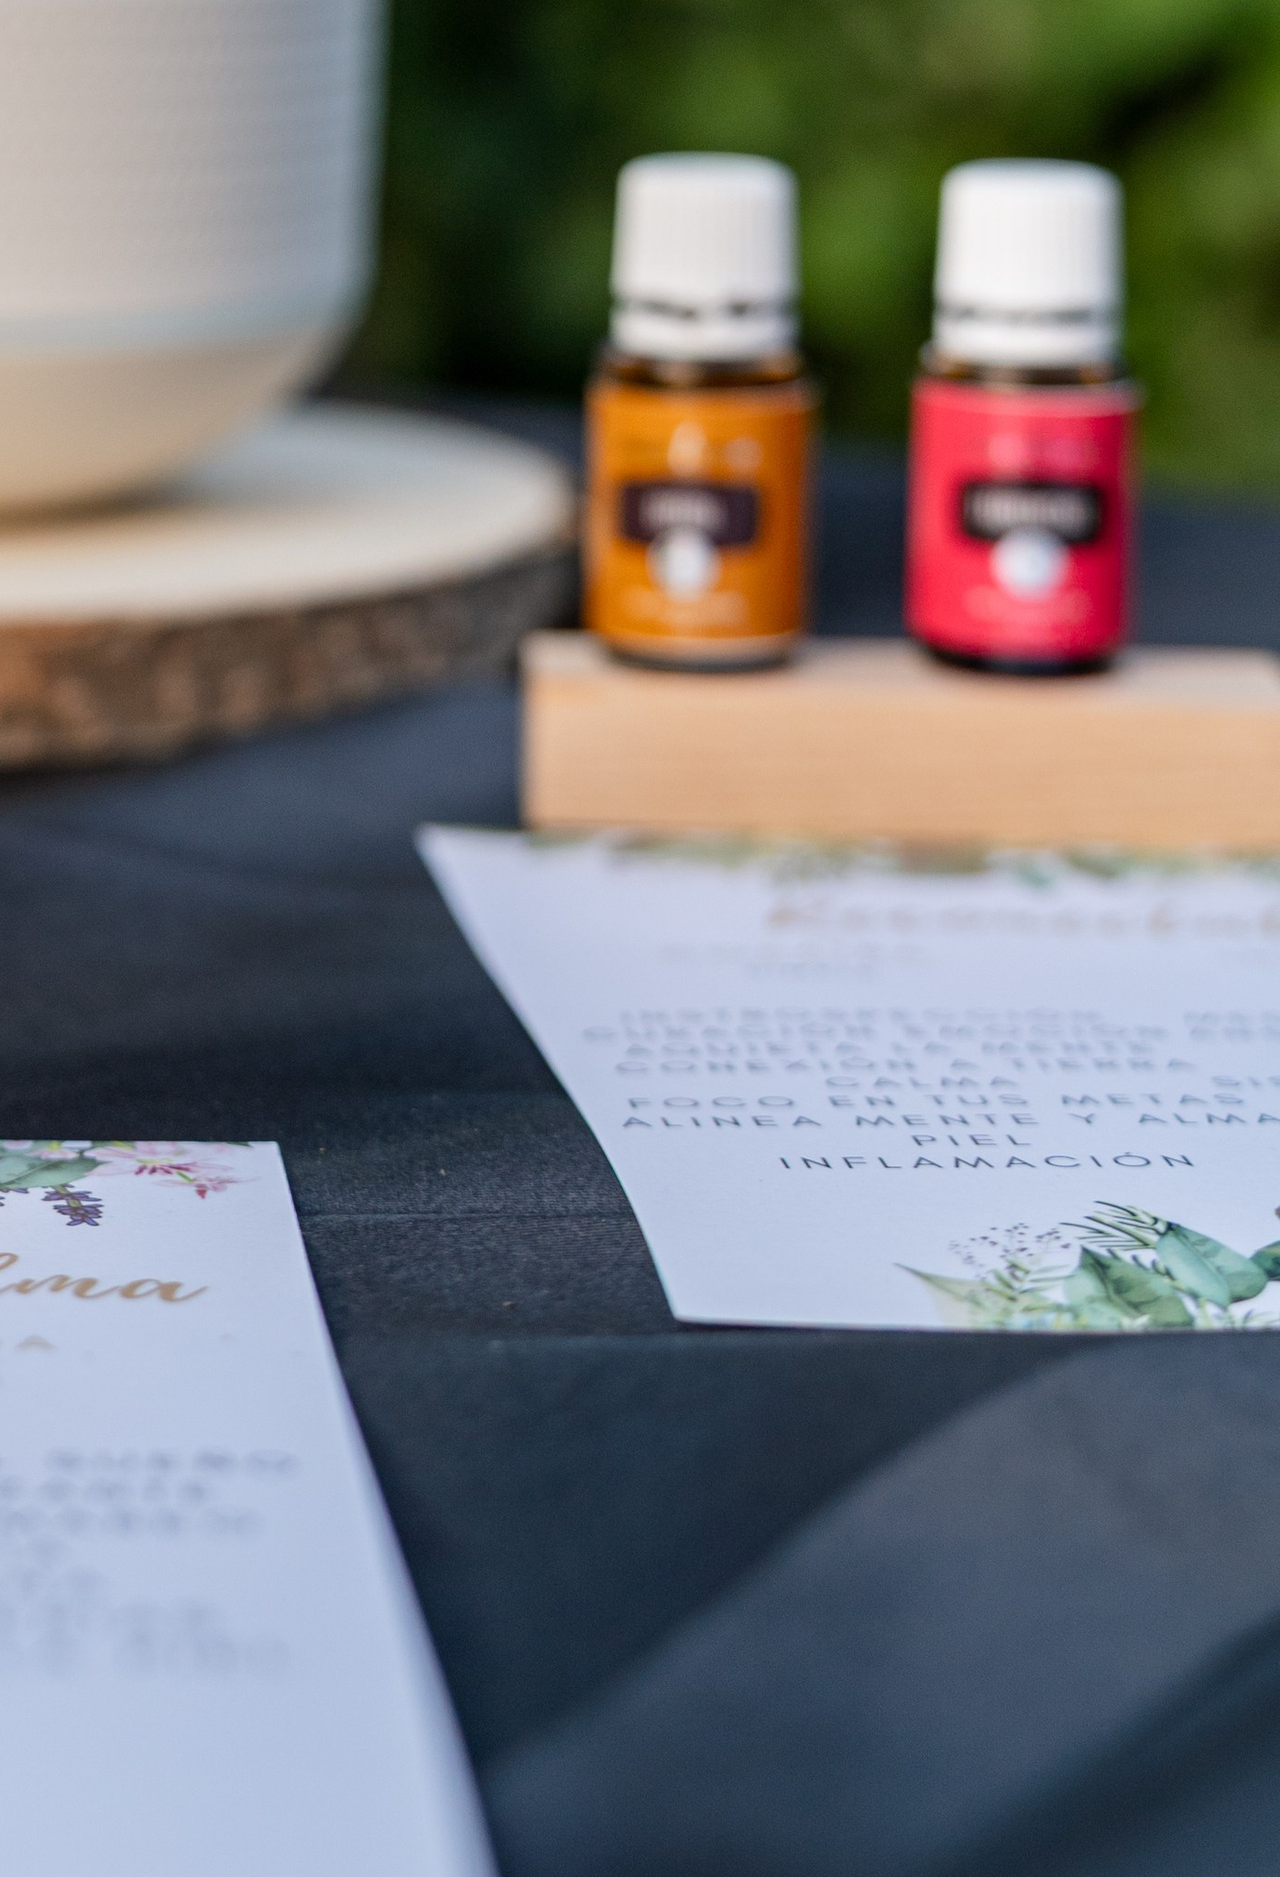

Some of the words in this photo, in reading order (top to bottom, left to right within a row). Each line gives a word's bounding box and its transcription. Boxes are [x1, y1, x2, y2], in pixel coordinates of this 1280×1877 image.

[825, 1075, 1021, 1089] CALMA
[627, 1096, 796, 1109] FOCO
[828, 1095, 896, 1107] EN
[923, 1093, 1029, 1106] TUS
[1061, 1093, 1245, 1105] METAS
[621, 1115, 823, 1127] ALINEA
[854, 1114, 1040, 1127] MENTE
[1068, 1112, 1097, 1125] Y
[1138, 1112, 1280, 1125] ALMA
[911, 1133, 1032, 1147] PIEL
[779, 1151, 1195, 1170] INFLAMACIÓN
